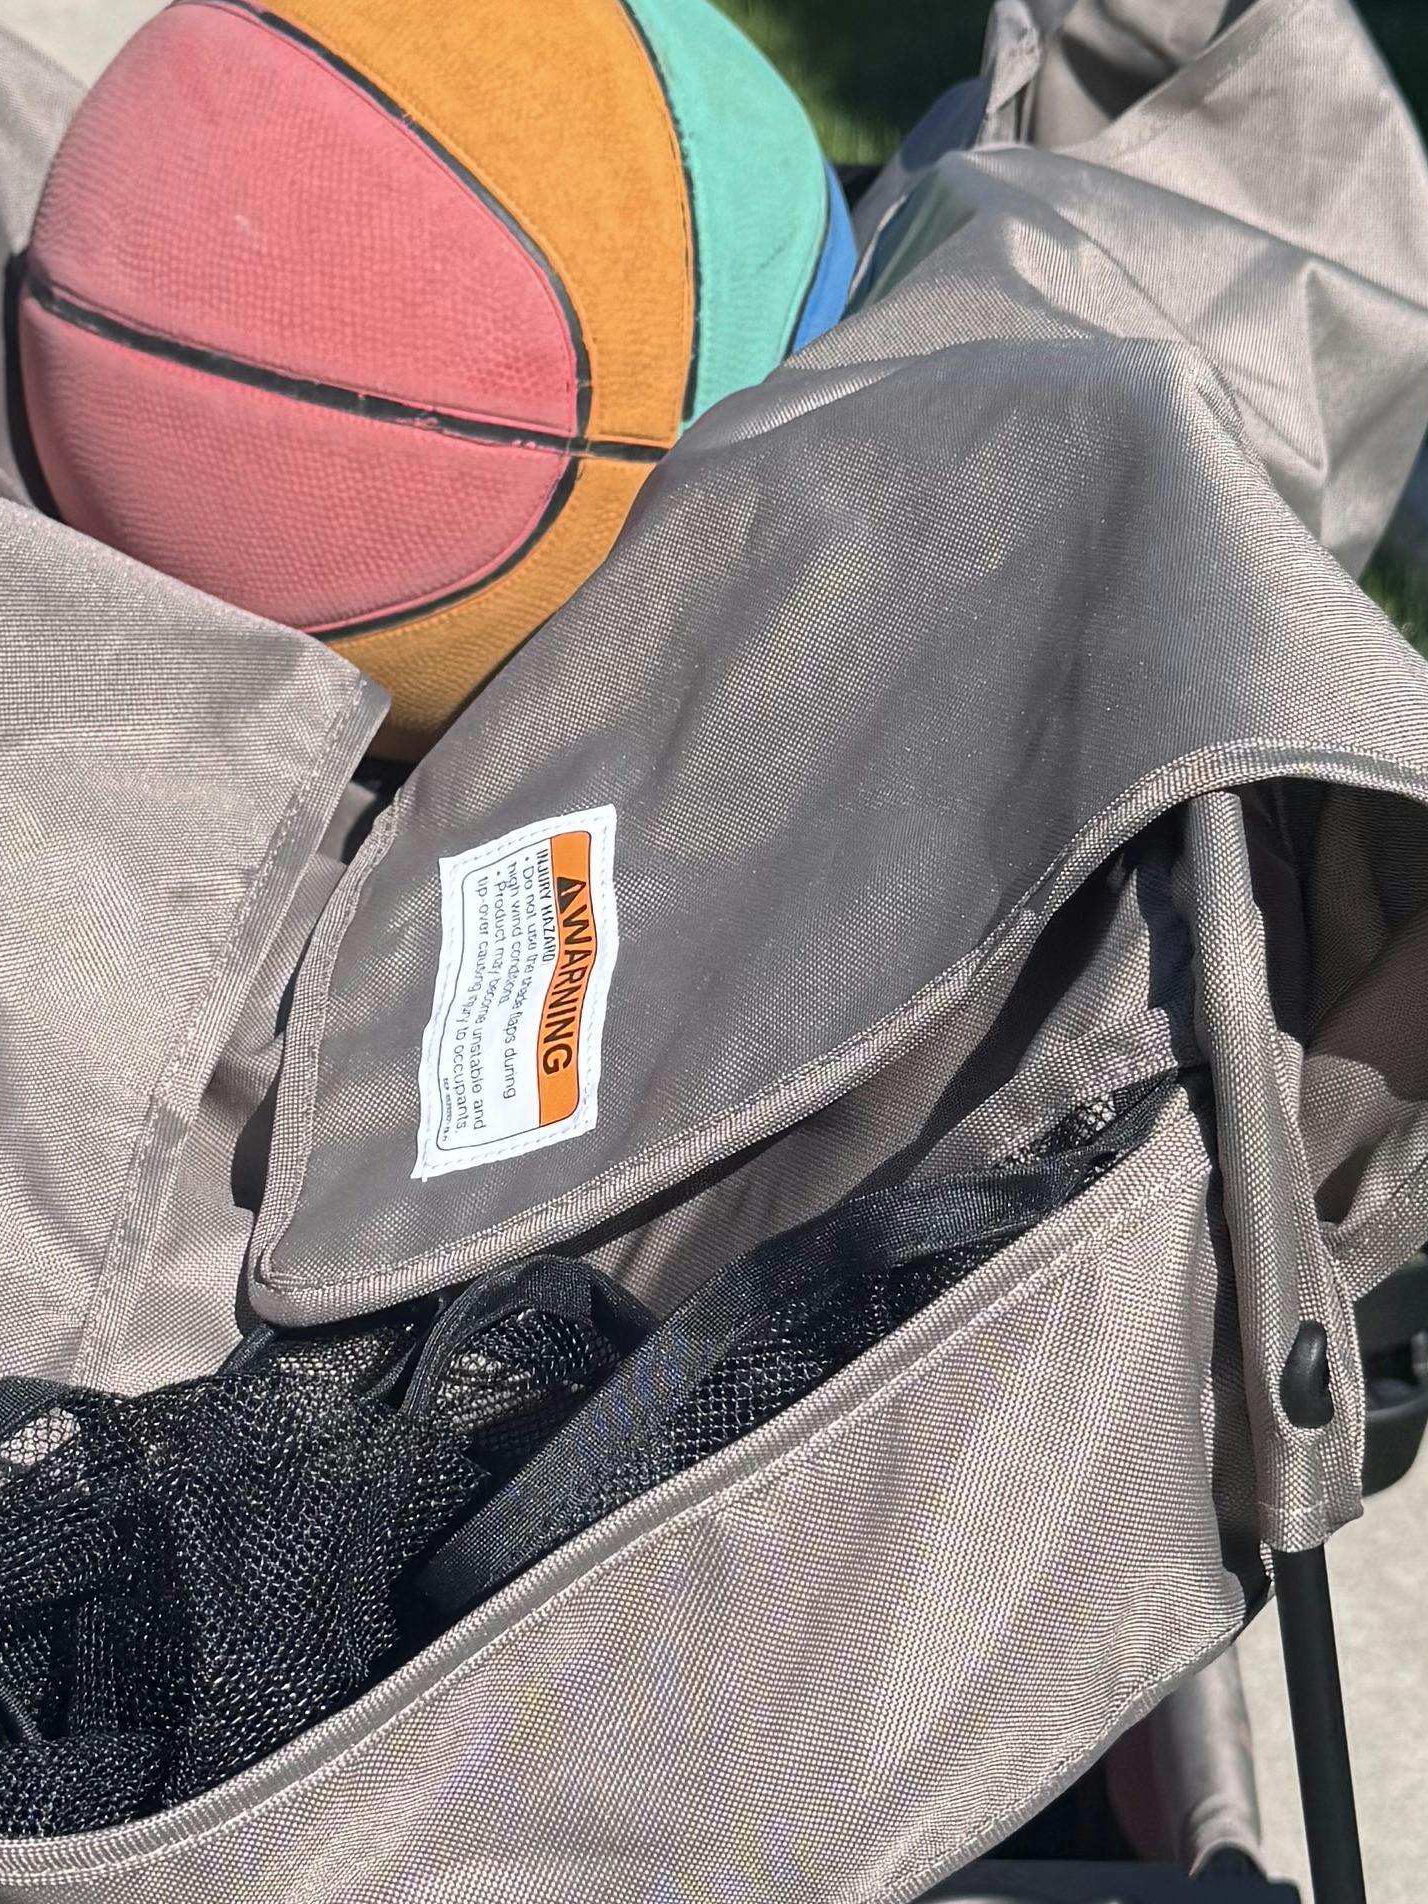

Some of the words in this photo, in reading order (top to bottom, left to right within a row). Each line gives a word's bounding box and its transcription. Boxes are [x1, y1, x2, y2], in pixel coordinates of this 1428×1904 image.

[505, 863, 520, 898] high
[522, 867, 535, 890] Do
[536, 849, 552, 900] INJURY
[476, 877, 490, 935] tip-over
[492, 881, 507, 945] Product
[510, 902, 523, 937] wind
[525, 895, 538, 918] not
[527, 924, 538, 950] use
[468, 941, 489, 993] causing
[489, 948, 505, 975] may
[524, 954, 539, 974] the
[475, 978, 502, 1023] become
[542, 904, 593, 1075] WARNING
[453, 1028, 468, 1041] to
[504, 1012, 523, 1043] flaps
[470, 1028, 485, 1093] unstable
[503, 1048, 522, 1099] during
[473, 1099, 487, 1130] and
